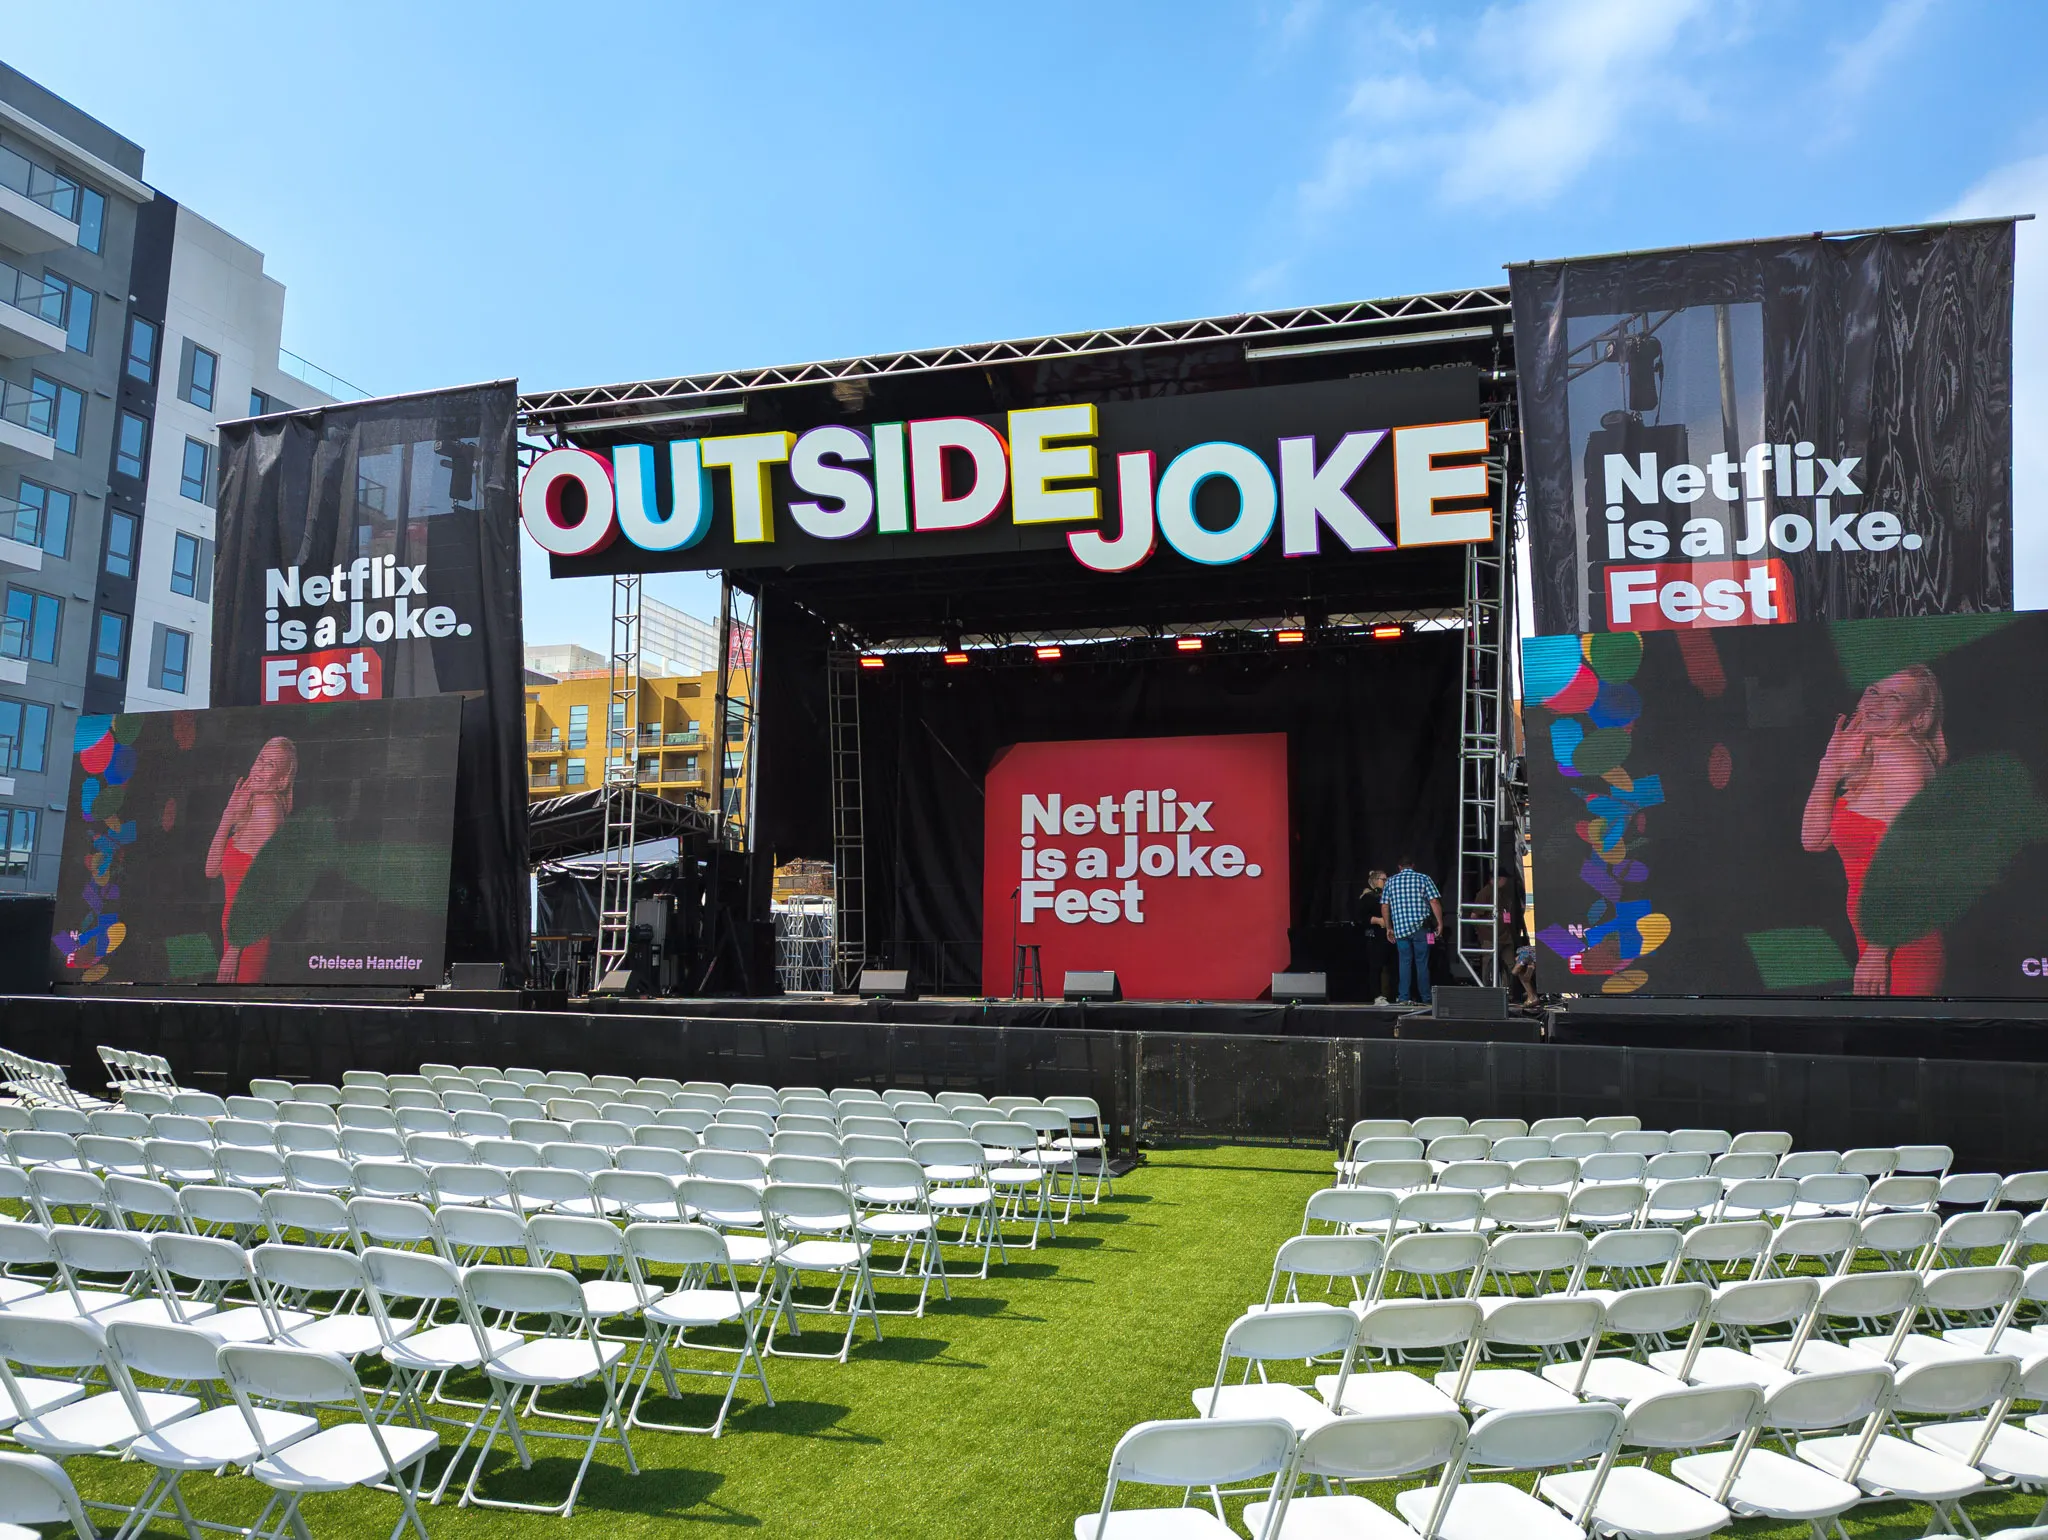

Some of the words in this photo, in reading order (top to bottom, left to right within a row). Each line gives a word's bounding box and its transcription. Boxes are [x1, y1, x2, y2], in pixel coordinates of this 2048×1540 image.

[520, 403, 1100, 556] OUTSIDE
[1066, 418, 1493, 573] JOKE
[1604, 441, 1864, 504] Netflix
[1606, 505, 1670, 560] is
[1681, 519, 1724, 558] a
[1736, 497, 1923, 556] Joke.
[266, 554, 427, 608] Netflix
[1610, 564, 1778, 624] Fest
[265, 608, 307, 651] is
[314, 616, 336, 647] a
[342, 597, 472, 644] Joke.
[265, 653, 370, 702] Fest
[1020, 788, 1214, 836] Netflix
[1020, 836, 1067, 880] is
[1075, 847, 1109, 879] a
[1115, 833, 1262, 880] Joke.
[1020, 879, 1144, 924] Fest
[308, 955, 363, 970] Chelsea
[366, 955, 423, 970] Handler
